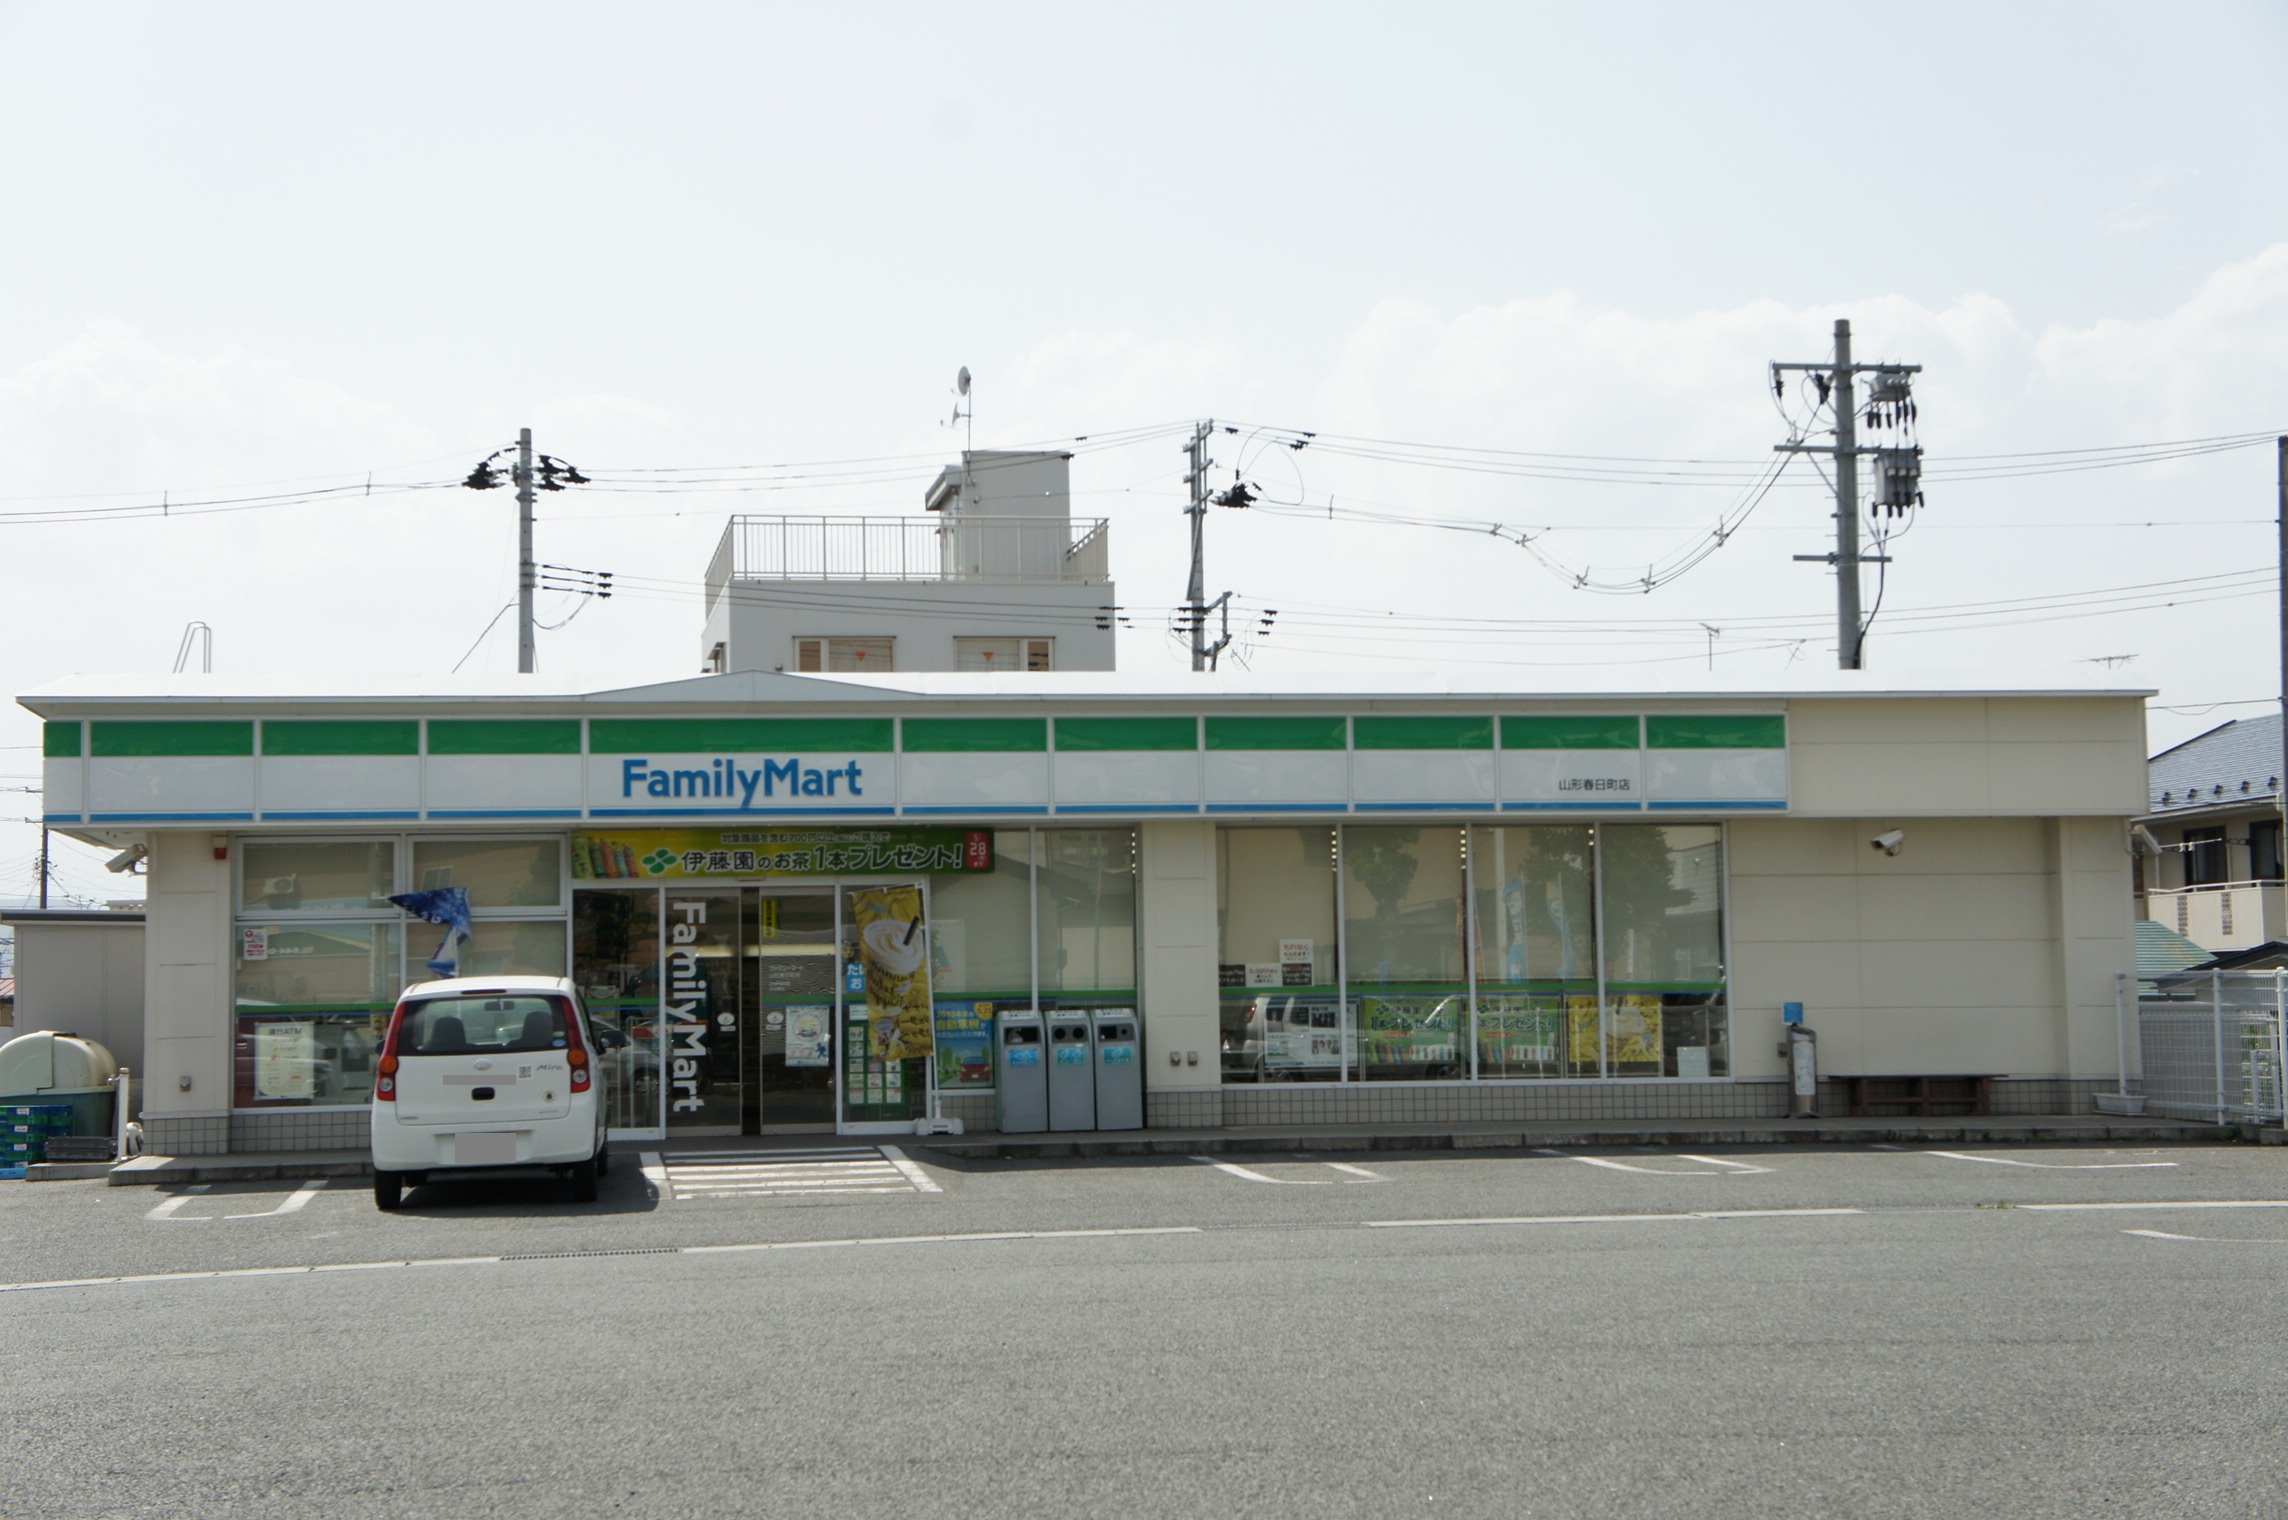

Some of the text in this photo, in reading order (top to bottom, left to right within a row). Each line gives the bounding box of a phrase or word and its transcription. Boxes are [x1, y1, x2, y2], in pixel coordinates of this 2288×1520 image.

[623, 758, 862, 809] FamilyMart
[1558, 778, 1630, 791] 山形春日町店
[970, 842, 986, 855] 28
[665, 902, 706, 1112] FamilyMart
